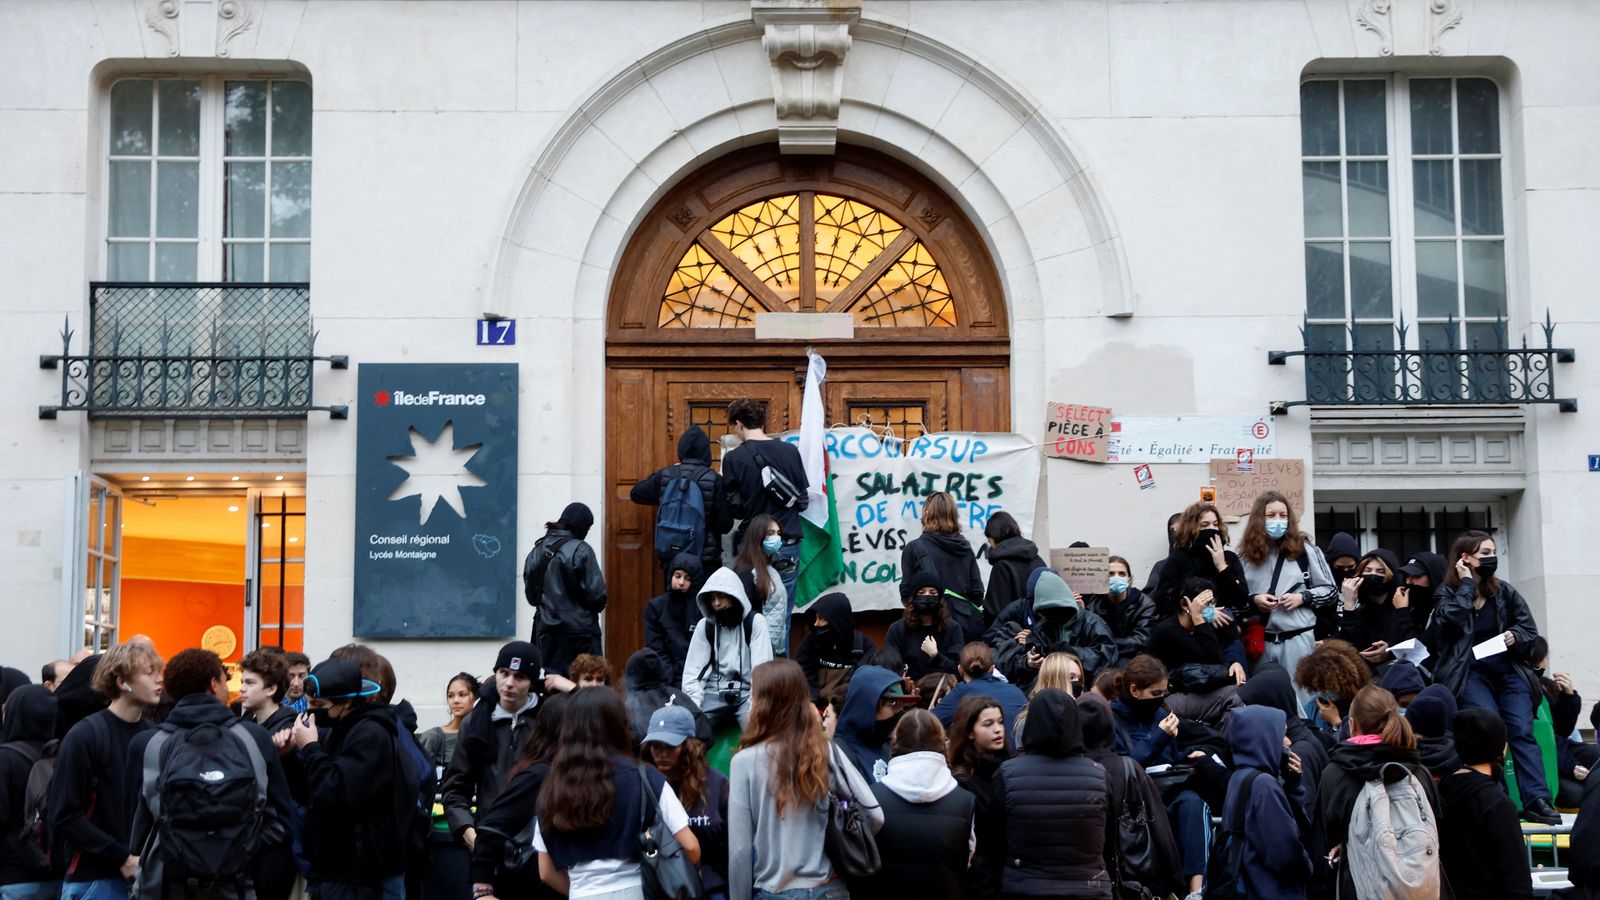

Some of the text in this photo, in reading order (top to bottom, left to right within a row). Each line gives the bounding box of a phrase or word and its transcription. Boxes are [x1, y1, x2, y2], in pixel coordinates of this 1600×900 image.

[480, 320, 512, 344] 17
[1048, 420, 1105, 439] PIÈGE À
[785, 433, 988, 463] RCOURSUP
[1055, 436, 1096, 457] CONS
[1149, 440, 1193, 456] Égalité
[1209, 443, 1272, 456] Fratité
[856, 471, 1004, 503] SALAIRES
[856, 500, 889, 528] DE
[369, 533, 450, 548] Conseil régional
[369, 549, 437, 562] Lycée Montaigne
[861, 559, 903, 584] COL
